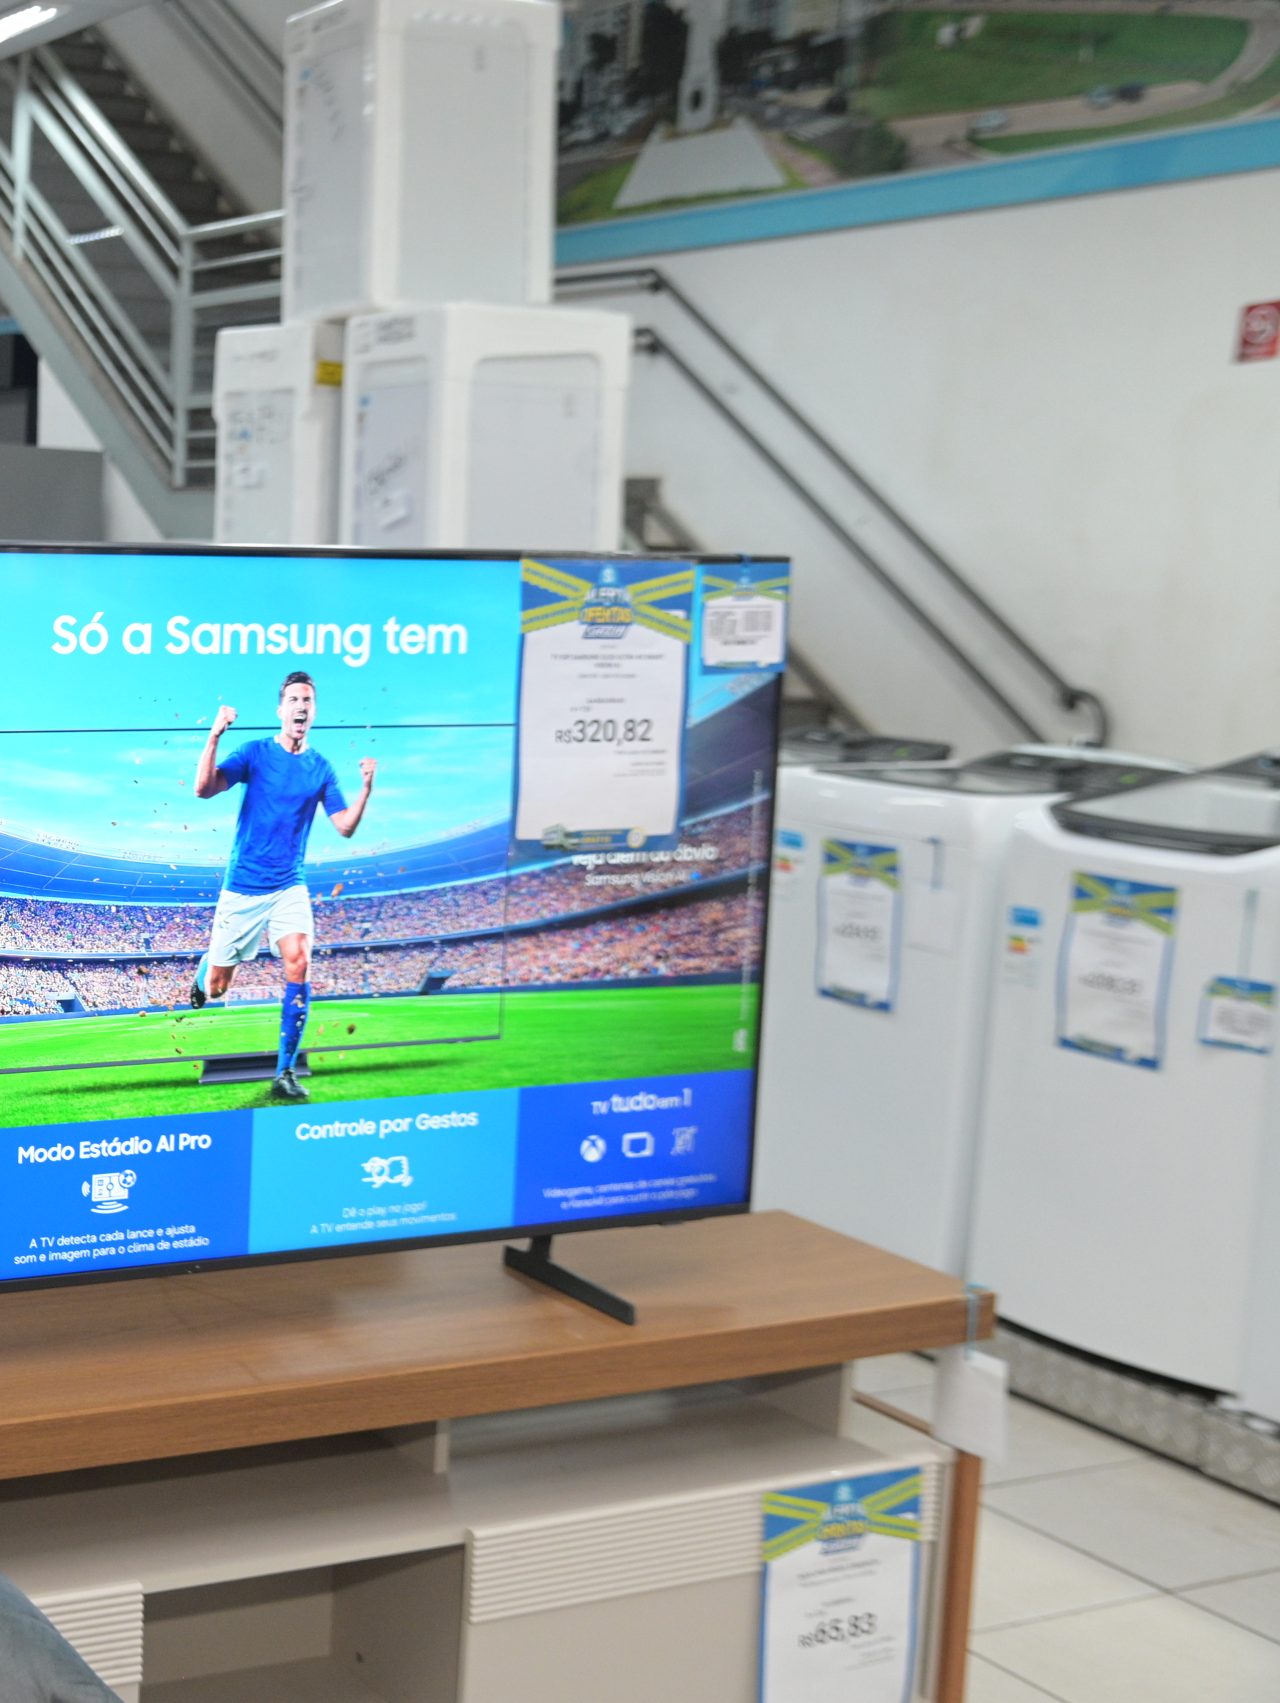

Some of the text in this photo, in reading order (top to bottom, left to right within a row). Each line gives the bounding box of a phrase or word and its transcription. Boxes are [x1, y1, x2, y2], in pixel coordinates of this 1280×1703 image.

[51, 611, 468, 668] Só a Samsung tem
[585, 873, 639, 888] Samsung
[591, 1088, 692, 1115] TV tudo em 1
[295, 1111, 479, 1141] Controle por Gestos
[18, 1132, 212, 1164] Modo Estádio AI Pro
[29, 1223, 195, 1249] A TV detecta cada lance e ajusta
[320, 1223, 333, 1233] TV
[335, 1219, 375, 1233] entende
[14, 1235, 210, 1265] som e imagem para o clima de estádio
